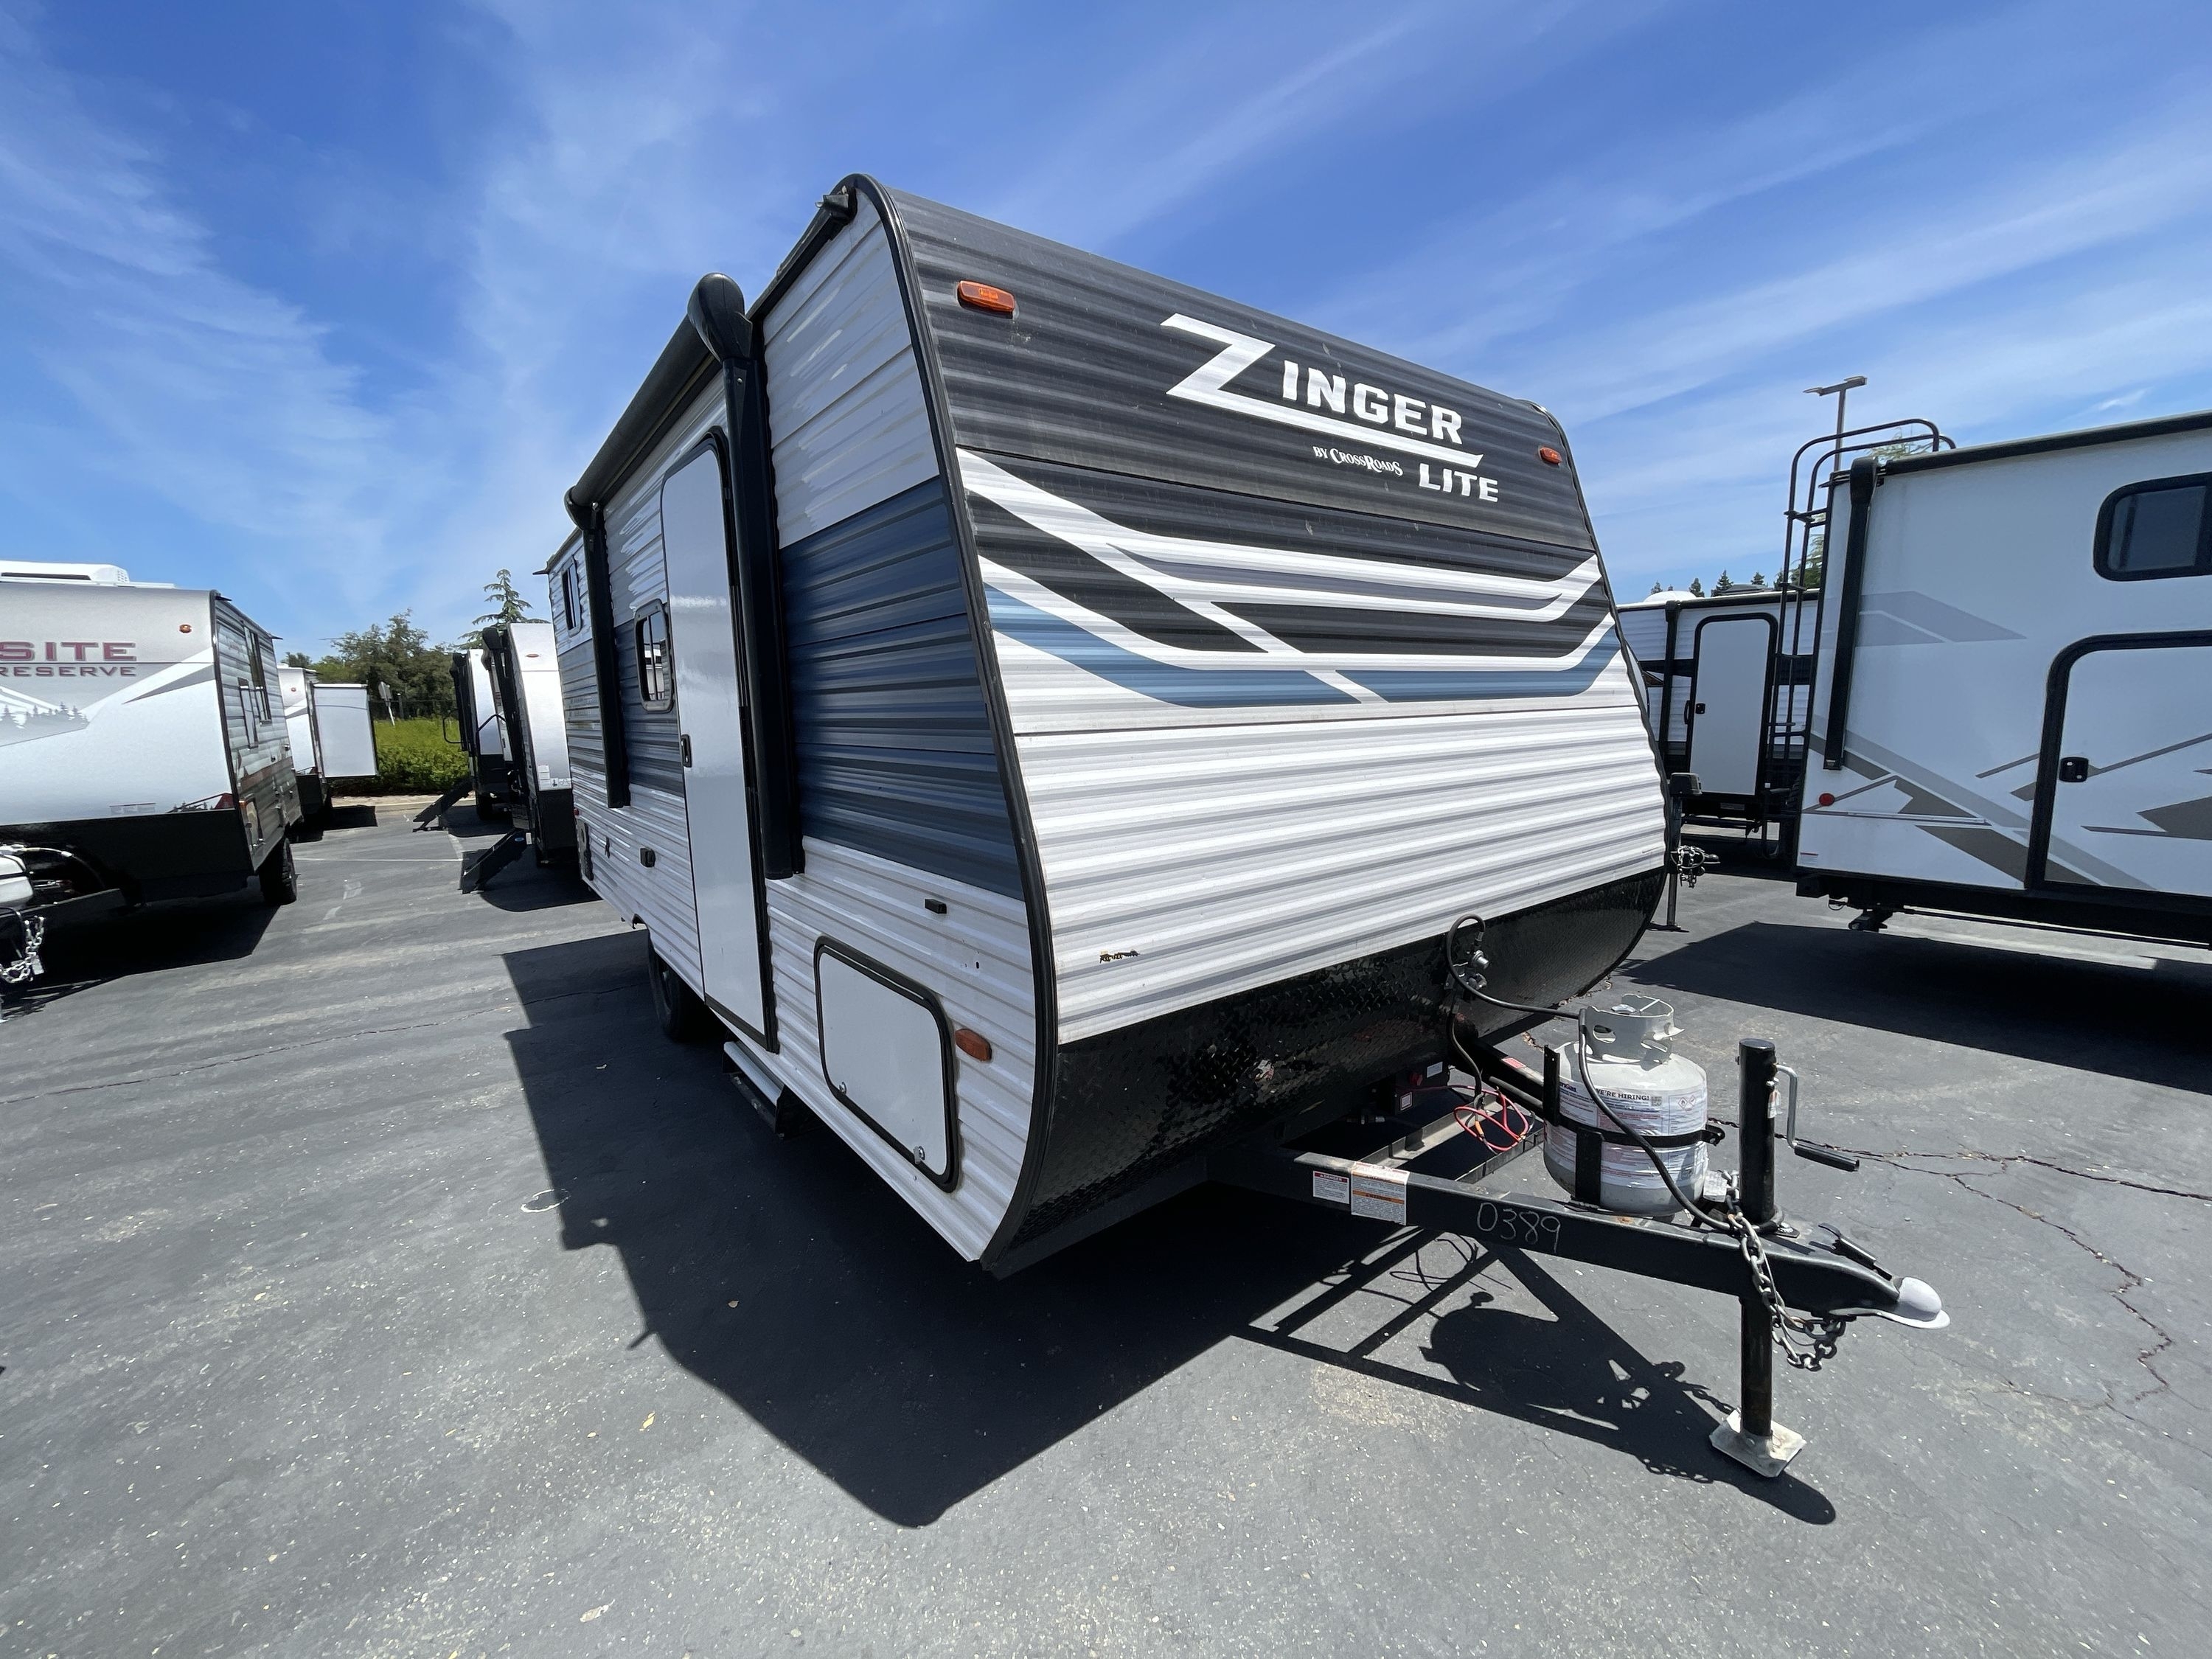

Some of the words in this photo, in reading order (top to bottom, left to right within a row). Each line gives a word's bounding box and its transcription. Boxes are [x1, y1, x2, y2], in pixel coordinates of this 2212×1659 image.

[1160, 313, 1484, 467] ZINGER
[1312, 446, 1328, 459] BY
[1419, 463, 1499, 503] LITE
[0, 641, 137, 661] SITE
[1618, 1093, 1649, 1101] HIRING!
[1477, 1202, 1561, 1253] 0389
